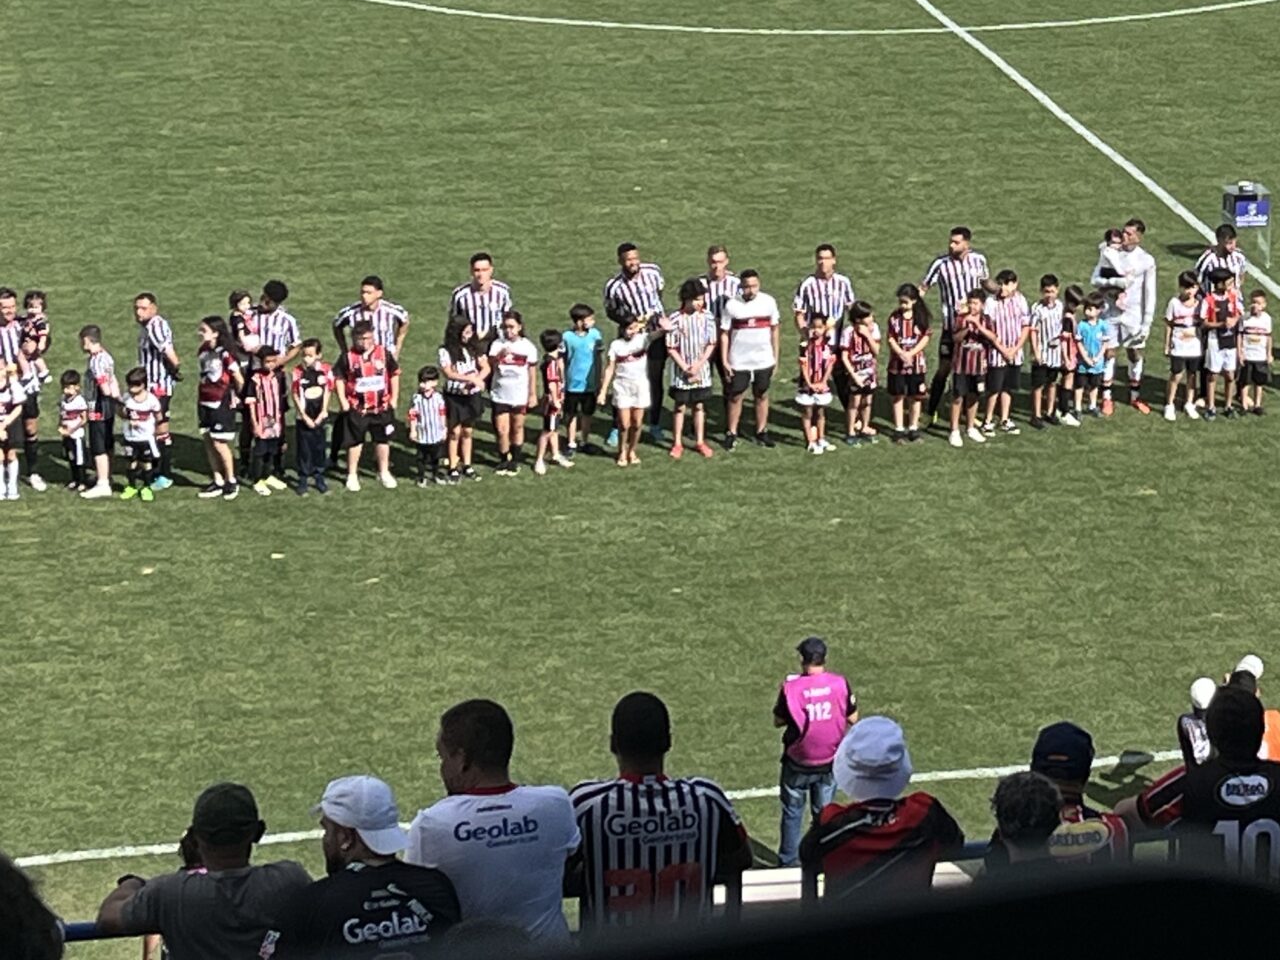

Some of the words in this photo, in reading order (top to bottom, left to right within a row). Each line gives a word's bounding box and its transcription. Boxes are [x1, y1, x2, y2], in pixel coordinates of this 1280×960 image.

[806, 701, 832, 722] 112
[453, 815, 539, 842] Geolab
[606, 808, 698, 837] Geolab
